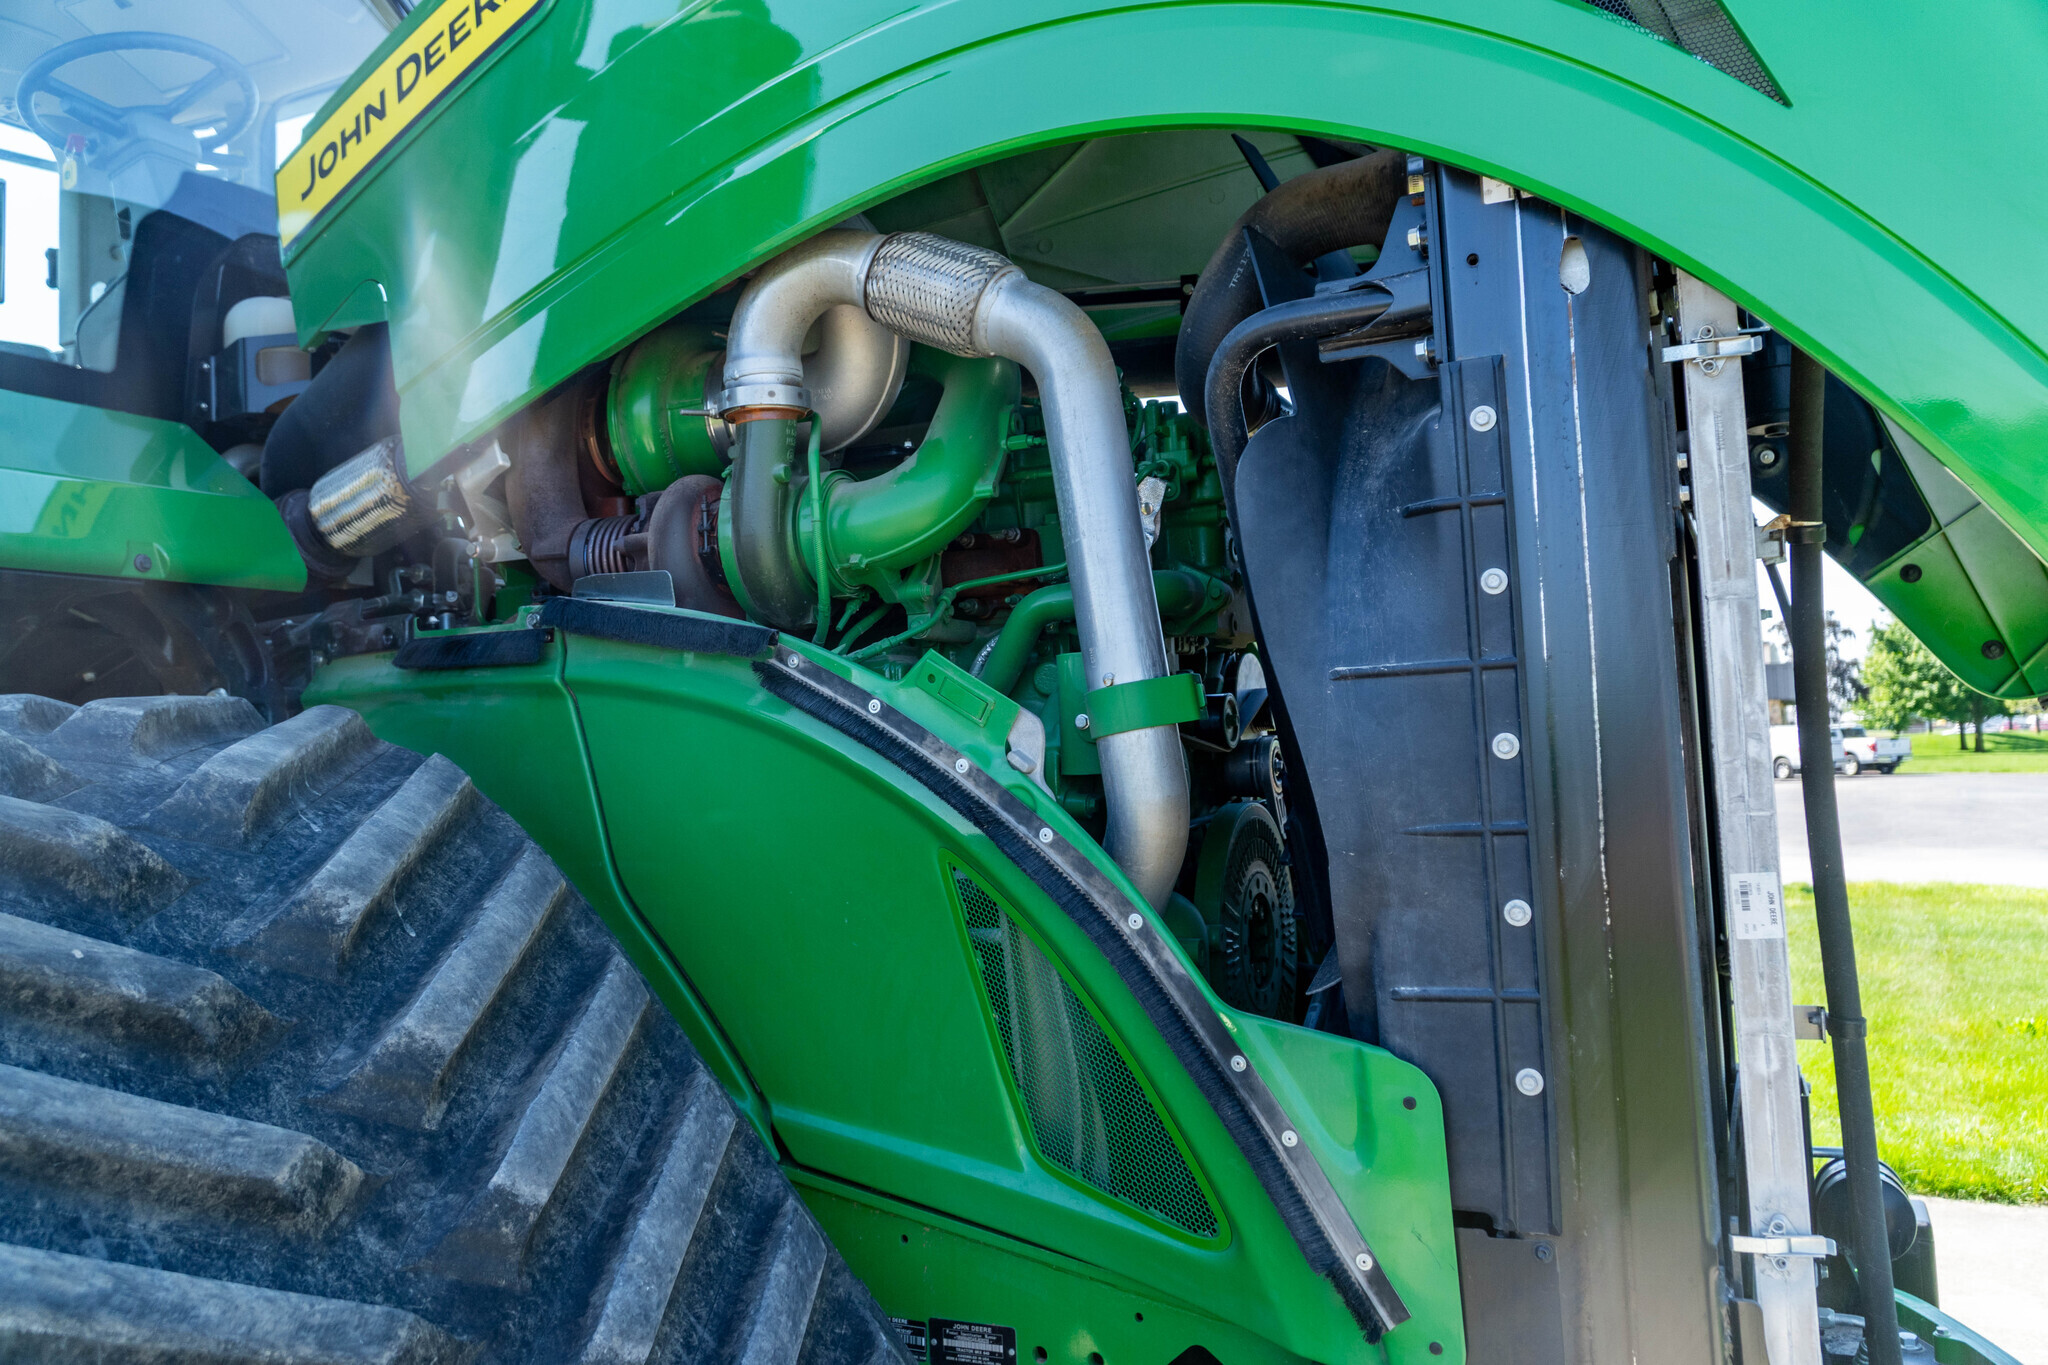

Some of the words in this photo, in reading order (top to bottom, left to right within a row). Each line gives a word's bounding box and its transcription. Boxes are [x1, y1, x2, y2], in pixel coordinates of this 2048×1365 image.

[301, 88, 387, 202] JOHN
[396, 0, 513, 104] DEER
[1767, 890, 1776, 905] JOHN
[1769, 907, 1778, 925] DEERE
[952, 1323, 970, 1332] JOHN
[971, 1325, 992, 1334] DEERE
